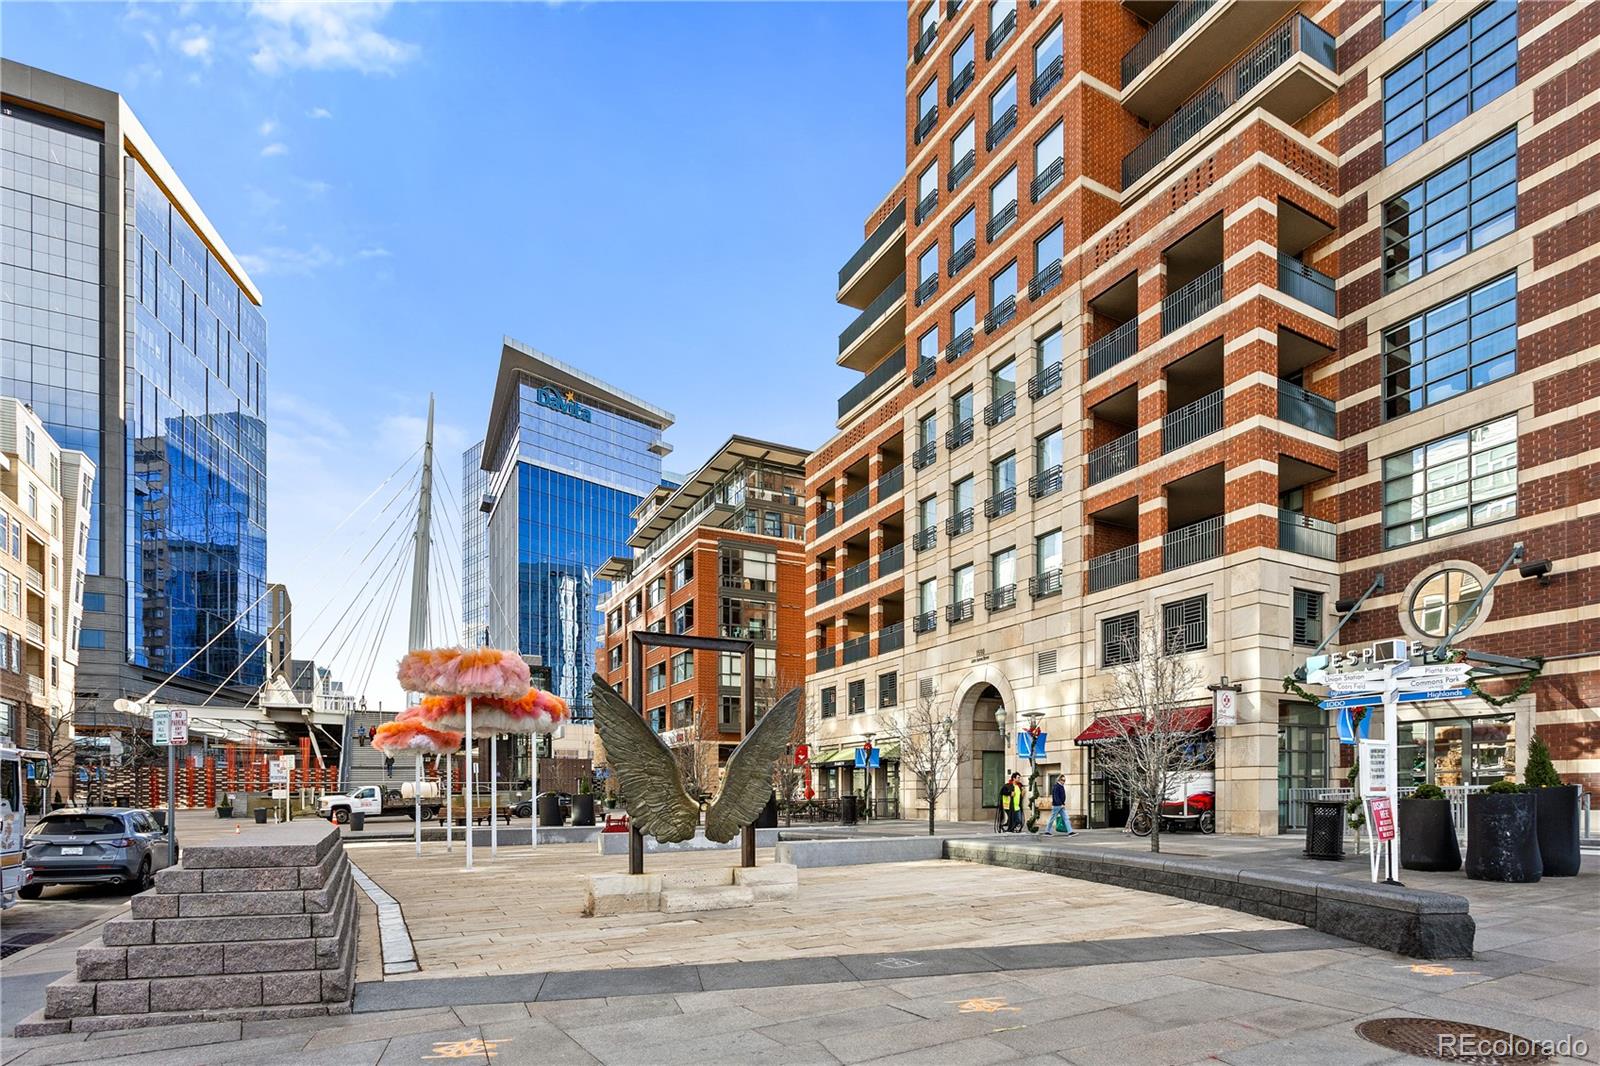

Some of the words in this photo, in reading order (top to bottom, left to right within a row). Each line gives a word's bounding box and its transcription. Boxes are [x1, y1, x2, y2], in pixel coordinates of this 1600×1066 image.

[537, 386, 592, 423] DaVita
[1331, 640, 1425, 667] ESPE
[1410, 679, 1443, 687] Commons
[1426, 689, 1463, 698] Highlands
[174, 711, 183, 719] NO
